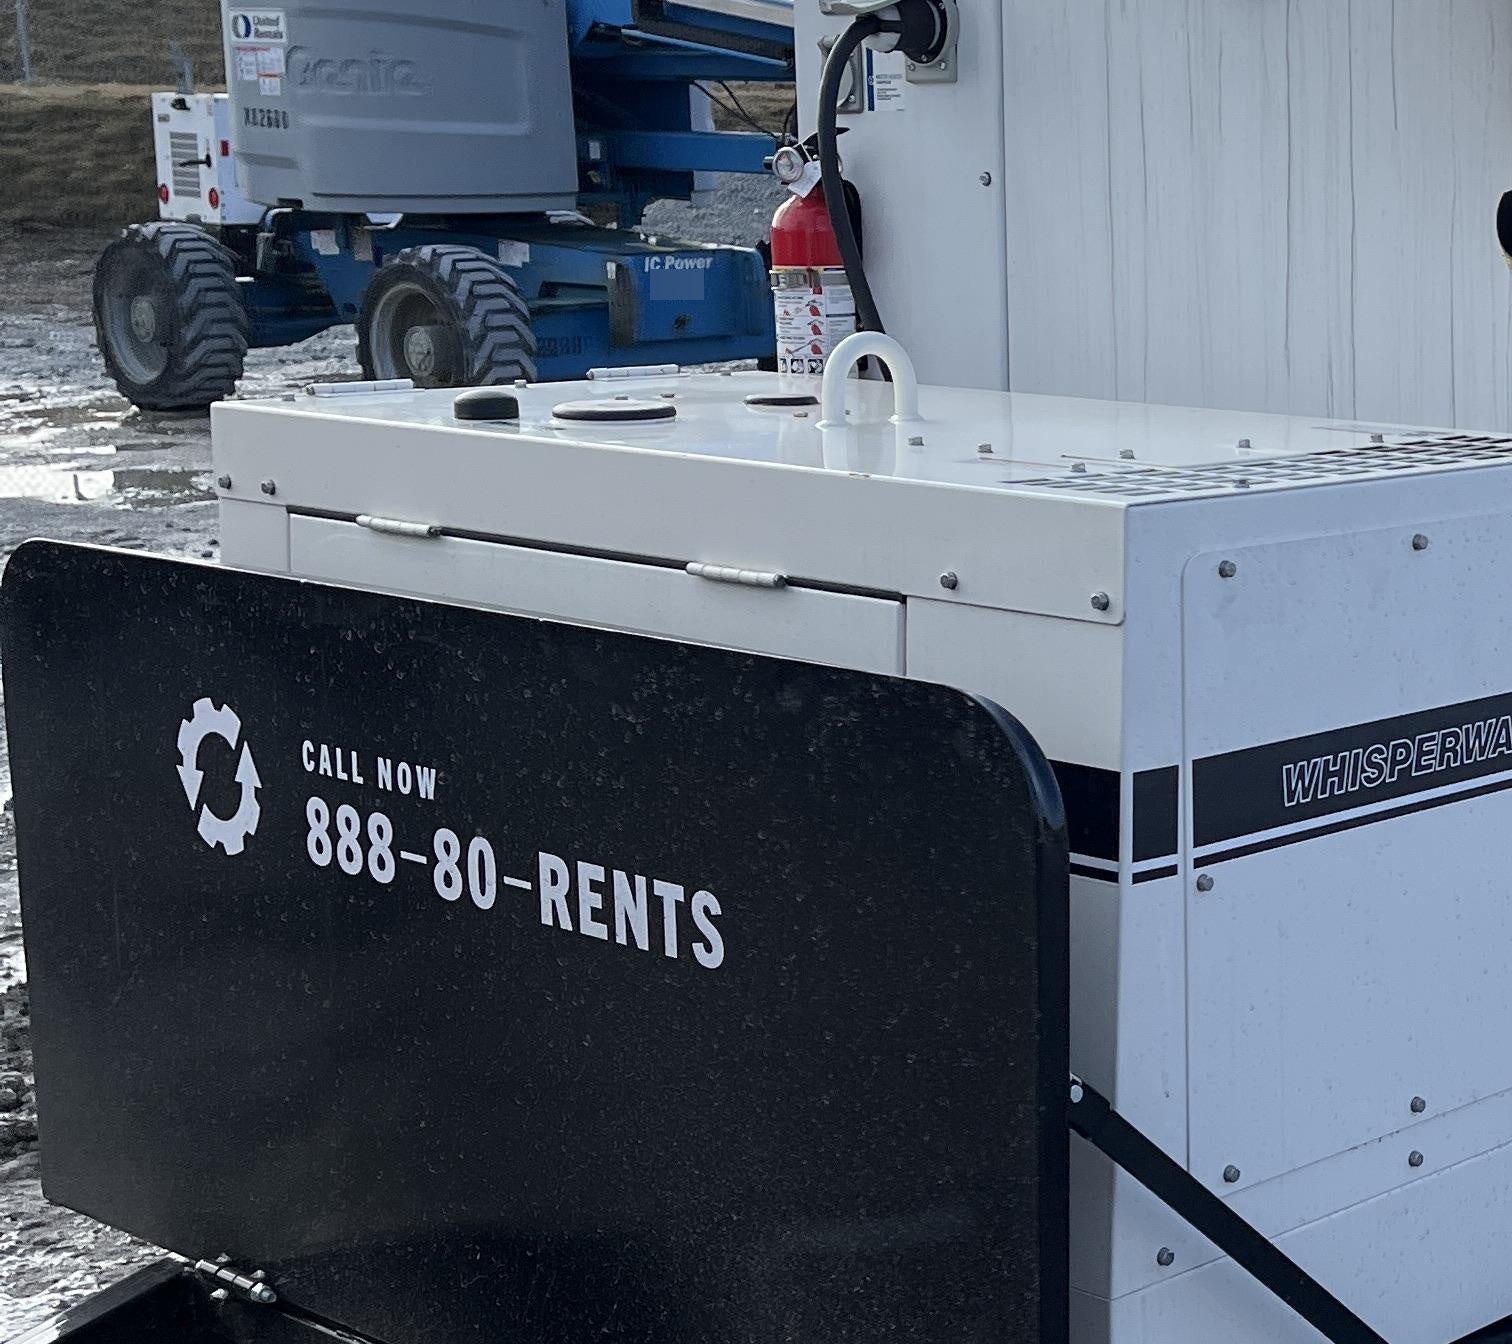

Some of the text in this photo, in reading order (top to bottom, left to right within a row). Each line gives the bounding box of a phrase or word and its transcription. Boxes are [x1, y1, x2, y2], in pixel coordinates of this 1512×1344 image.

[664, 255, 714, 270] Power
[302, 740, 437, 801] CALL NOW
[305, 796, 726, 969] 888-80-RENTS
